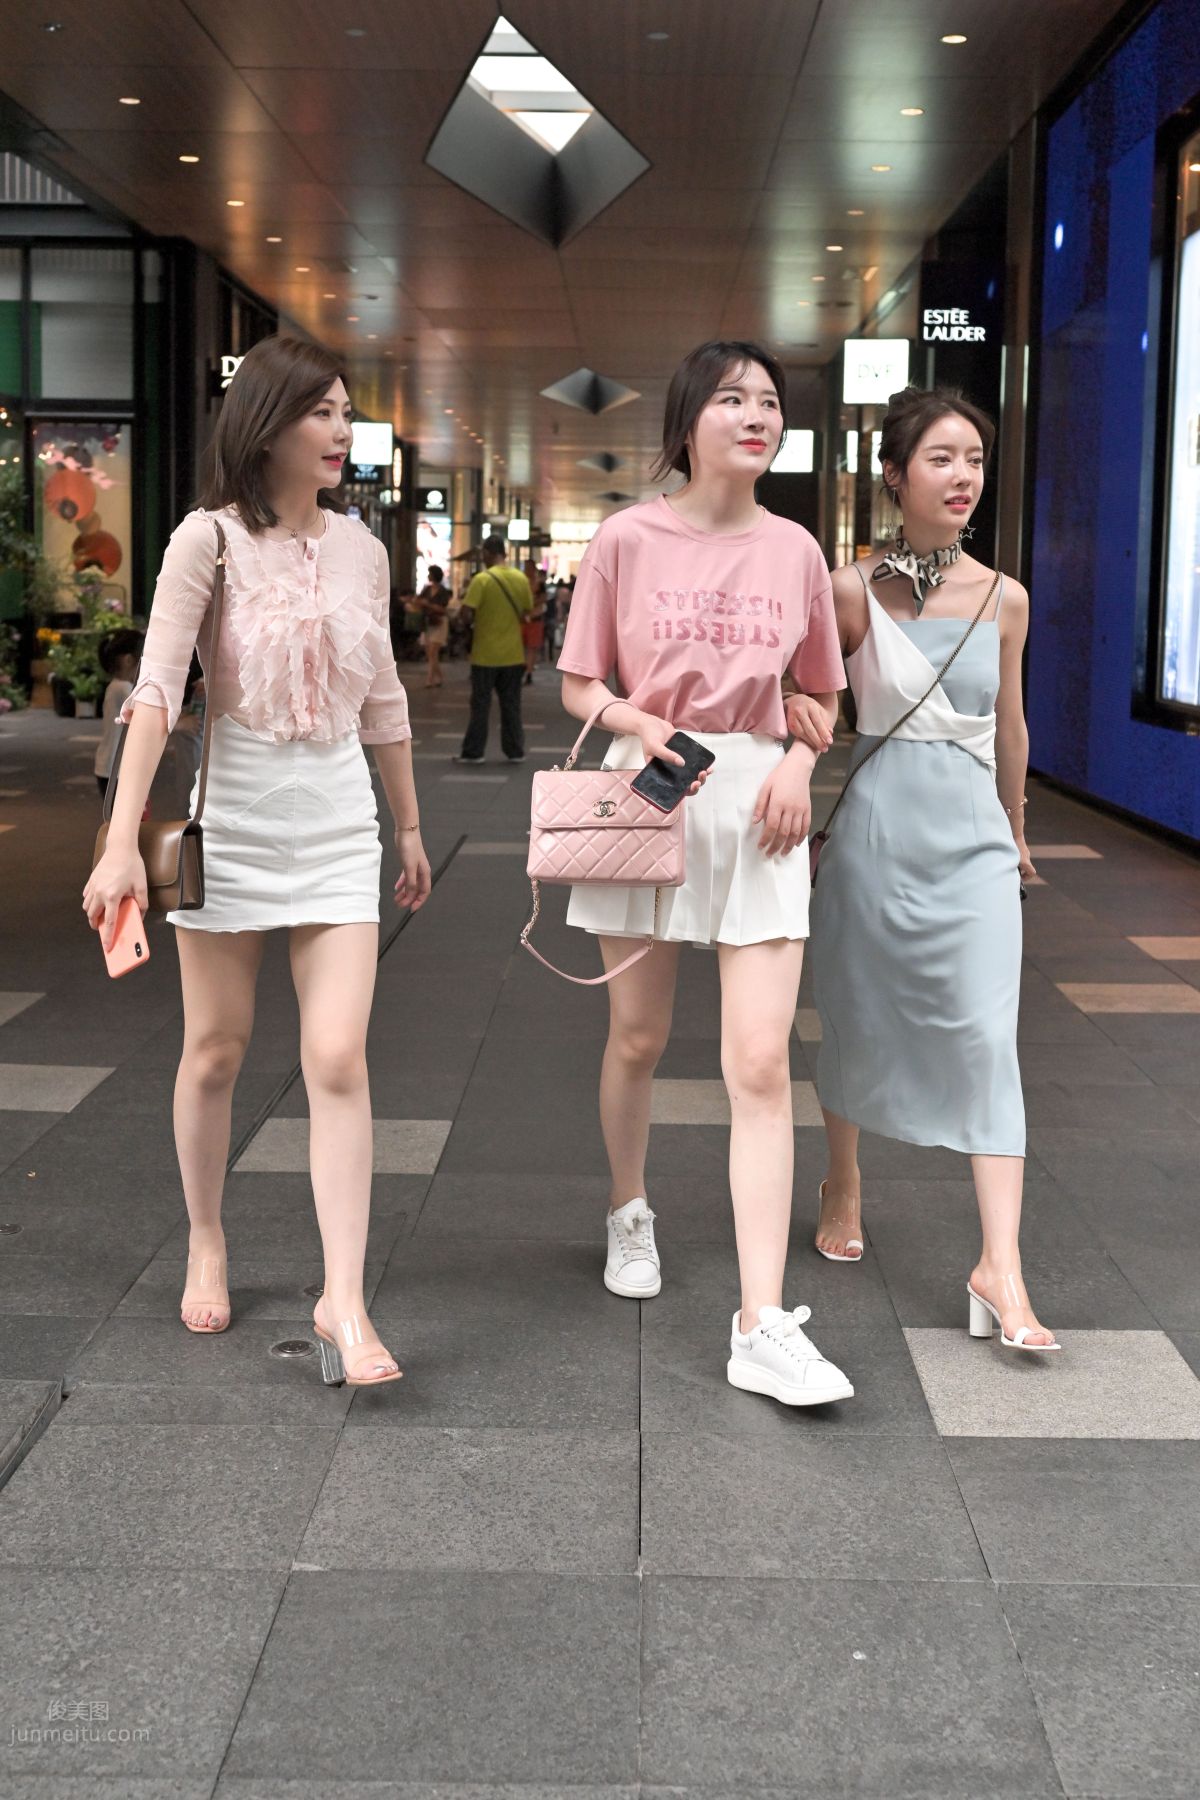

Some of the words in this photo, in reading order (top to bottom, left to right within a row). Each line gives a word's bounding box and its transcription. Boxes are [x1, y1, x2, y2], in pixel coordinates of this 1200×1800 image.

[923, 326, 986, 341] LAUDER
[655, 589, 783, 621] STRESS!!
[652, 618, 781, 648] STRESS!!
